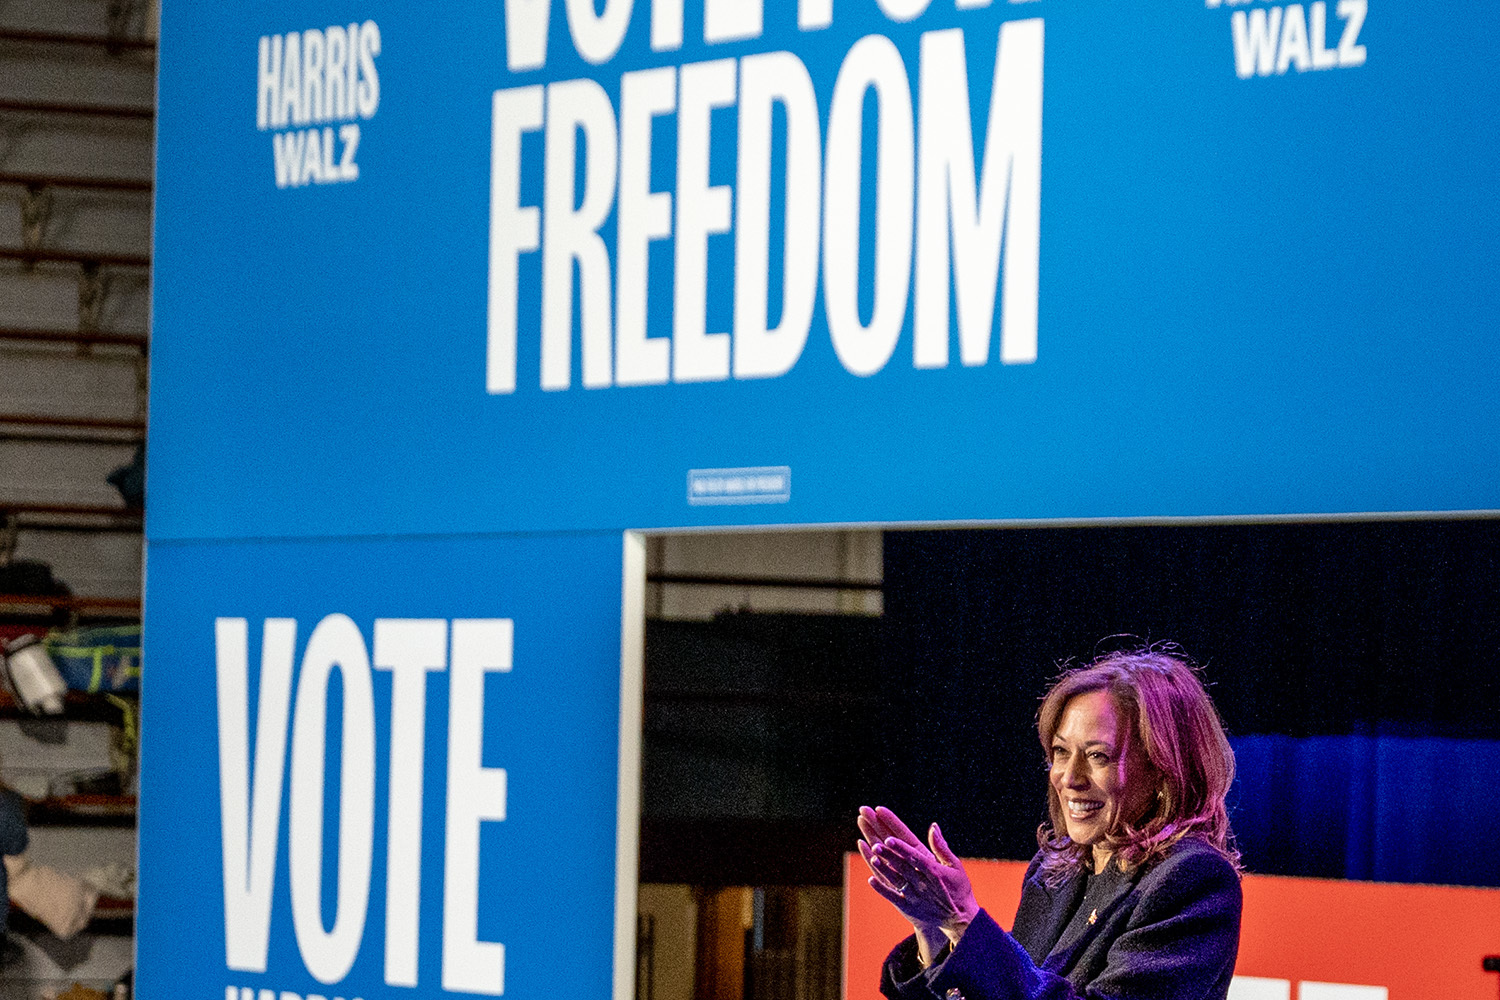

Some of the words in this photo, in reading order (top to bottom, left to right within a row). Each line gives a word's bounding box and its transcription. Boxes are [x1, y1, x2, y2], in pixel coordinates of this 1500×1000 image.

[256, 20, 381, 130] HARRIS
[1231, 0, 1368, 80] WALZ
[273, 125, 360, 188] WALZ
[486, 17, 1045, 394] FREEDOM
[215, 613, 514, 995] VOTE
